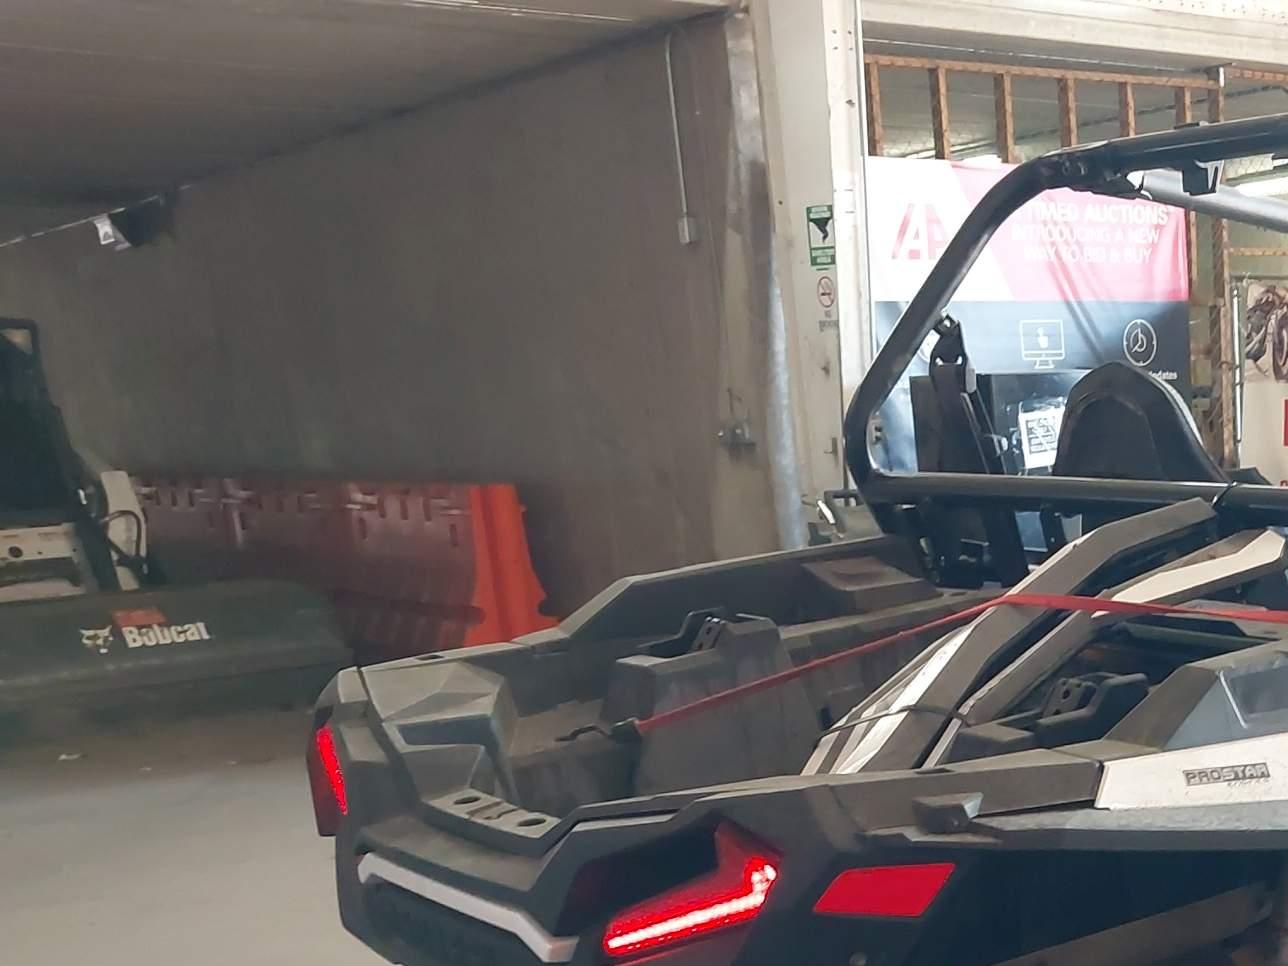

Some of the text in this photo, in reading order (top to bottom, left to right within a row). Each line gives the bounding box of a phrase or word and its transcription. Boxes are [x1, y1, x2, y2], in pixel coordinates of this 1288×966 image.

[1084, 203, 1170, 225] AUCTIONS
[1011, 224, 1160, 244] INTRODUCING A NEW
[1060, 246, 1080, 262] TO
[1084, 247, 1106, 262] BID
[1124, 248, 1152, 263] BUY
[121, 621, 211, 648] Bobcat
[1184, 763, 1270, 786] PROSTAR
